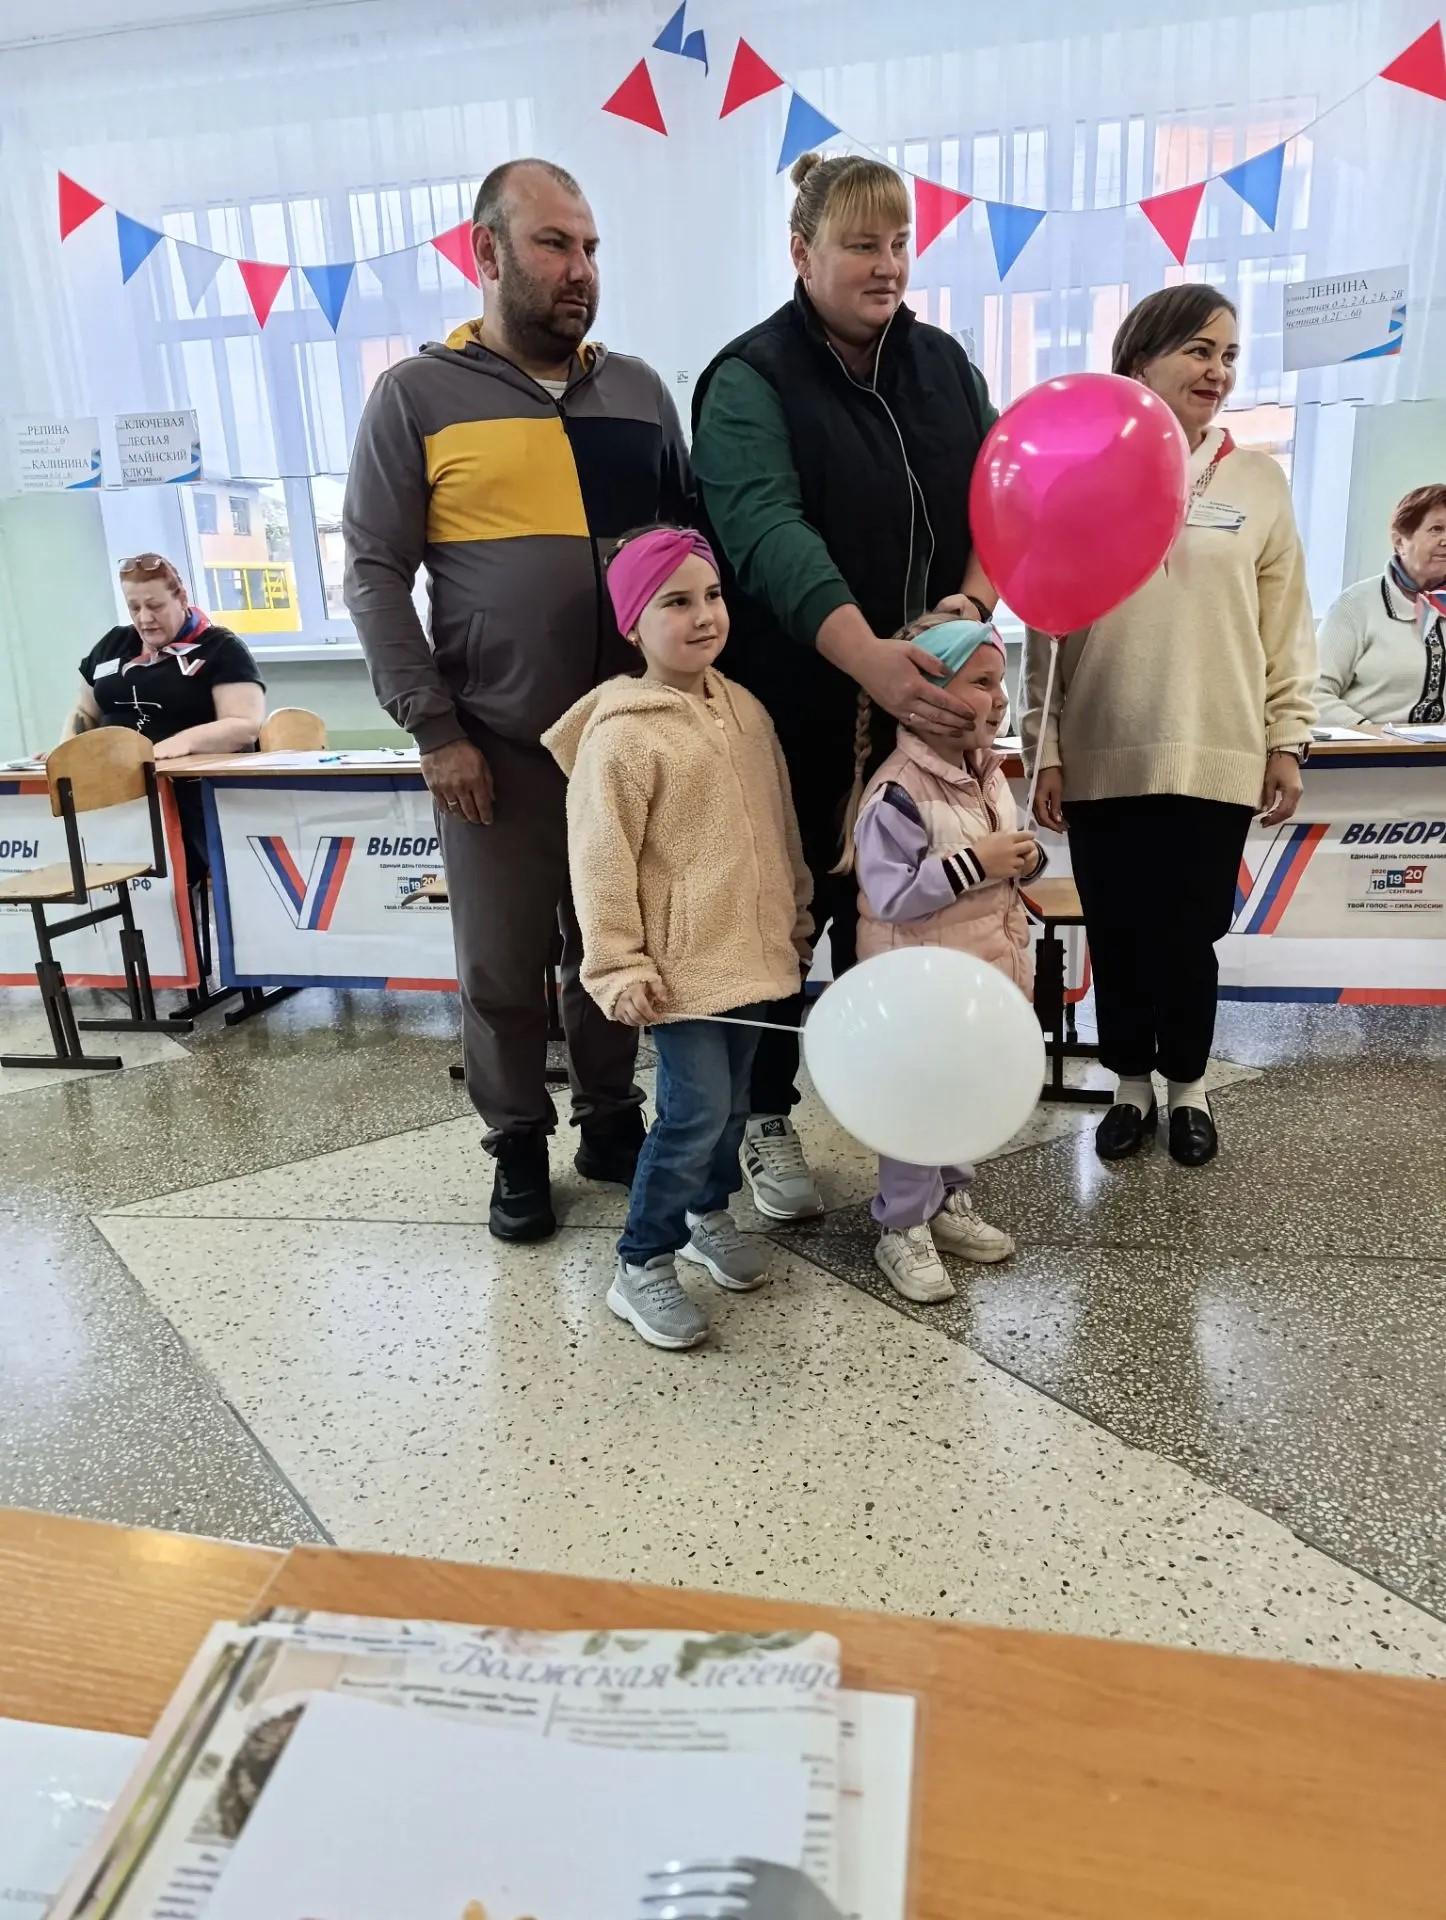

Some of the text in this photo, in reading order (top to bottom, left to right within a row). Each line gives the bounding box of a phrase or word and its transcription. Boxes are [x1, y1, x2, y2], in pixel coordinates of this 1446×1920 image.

[1304, 280, 1368, 299] ЛЕНИНА
[124, 417, 185, 430] КЛЮЧЕВАЯ
[27, 425, 70, 436] РЕПИНА
[128, 434, 169, 446] ЛЕСНАЯ
[32, 458, 89, 470] КАЛИНИНА
[122, 467, 153, 478] КЛЮЧ
[367, 836, 444, 856] ВЫБОР
[1373, 869, 1421, 889] 18 19 20
[400, 886, 409, 894] 18
[411, 881, 421, 890] 19
[438, 1641, 671, 1688] Волжская
